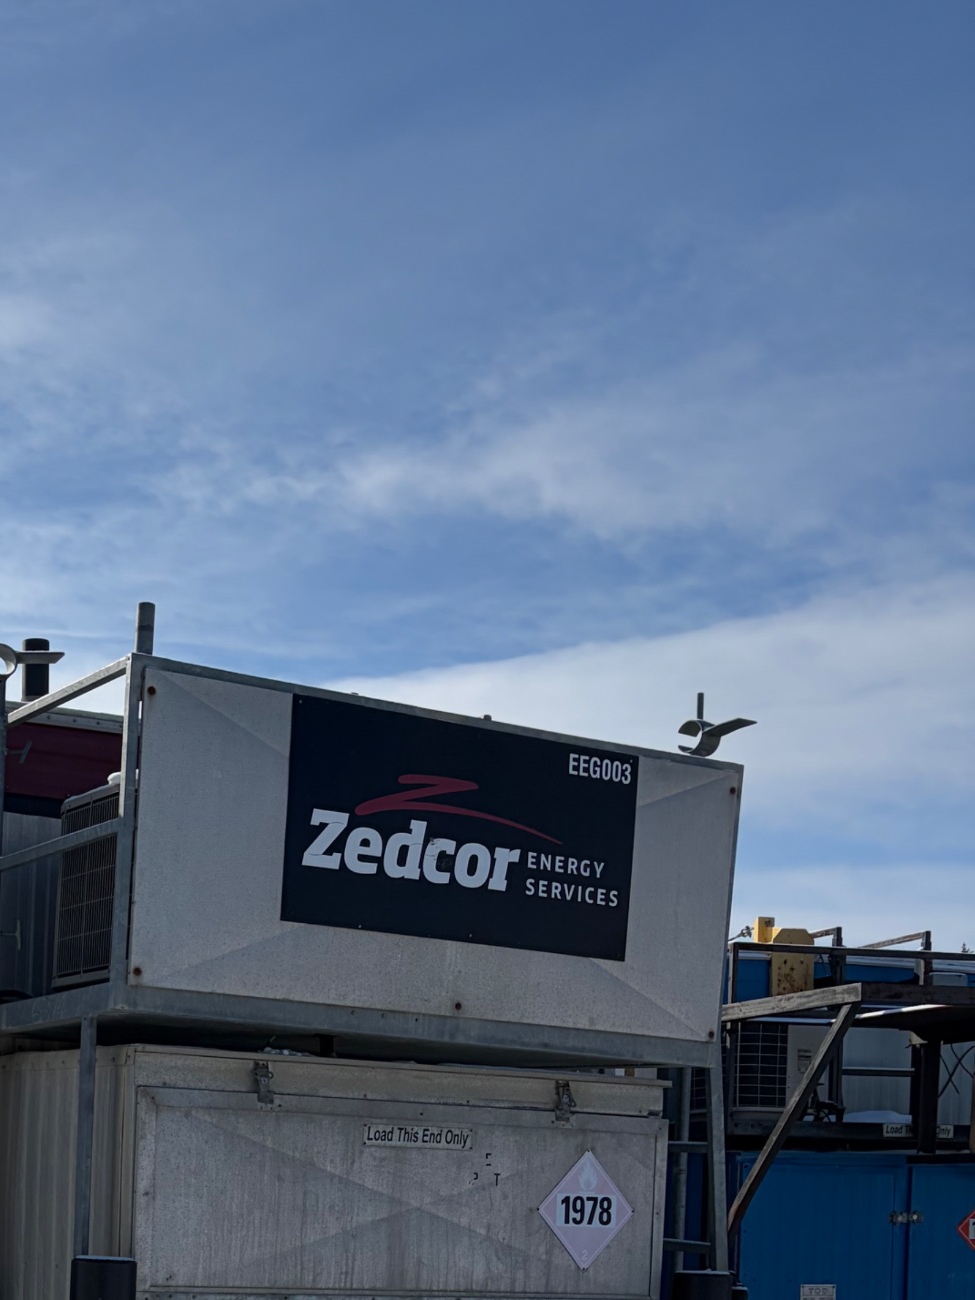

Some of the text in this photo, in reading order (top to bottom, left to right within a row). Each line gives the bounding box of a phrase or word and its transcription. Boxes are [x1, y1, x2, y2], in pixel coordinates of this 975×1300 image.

[568, 753, 632, 785] EEG003
[301, 808, 521, 891] Zedcor
[527, 851, 605, 879] ENERGY
[525, 878, 618, 907] SERVICES
[366, 1125, 469, 1149] Load This End Only
[885, 1125, 903, 1134] Load
[560, 1195, 613, 1226] 1978
[581, 1249, 588, 1261] 2
